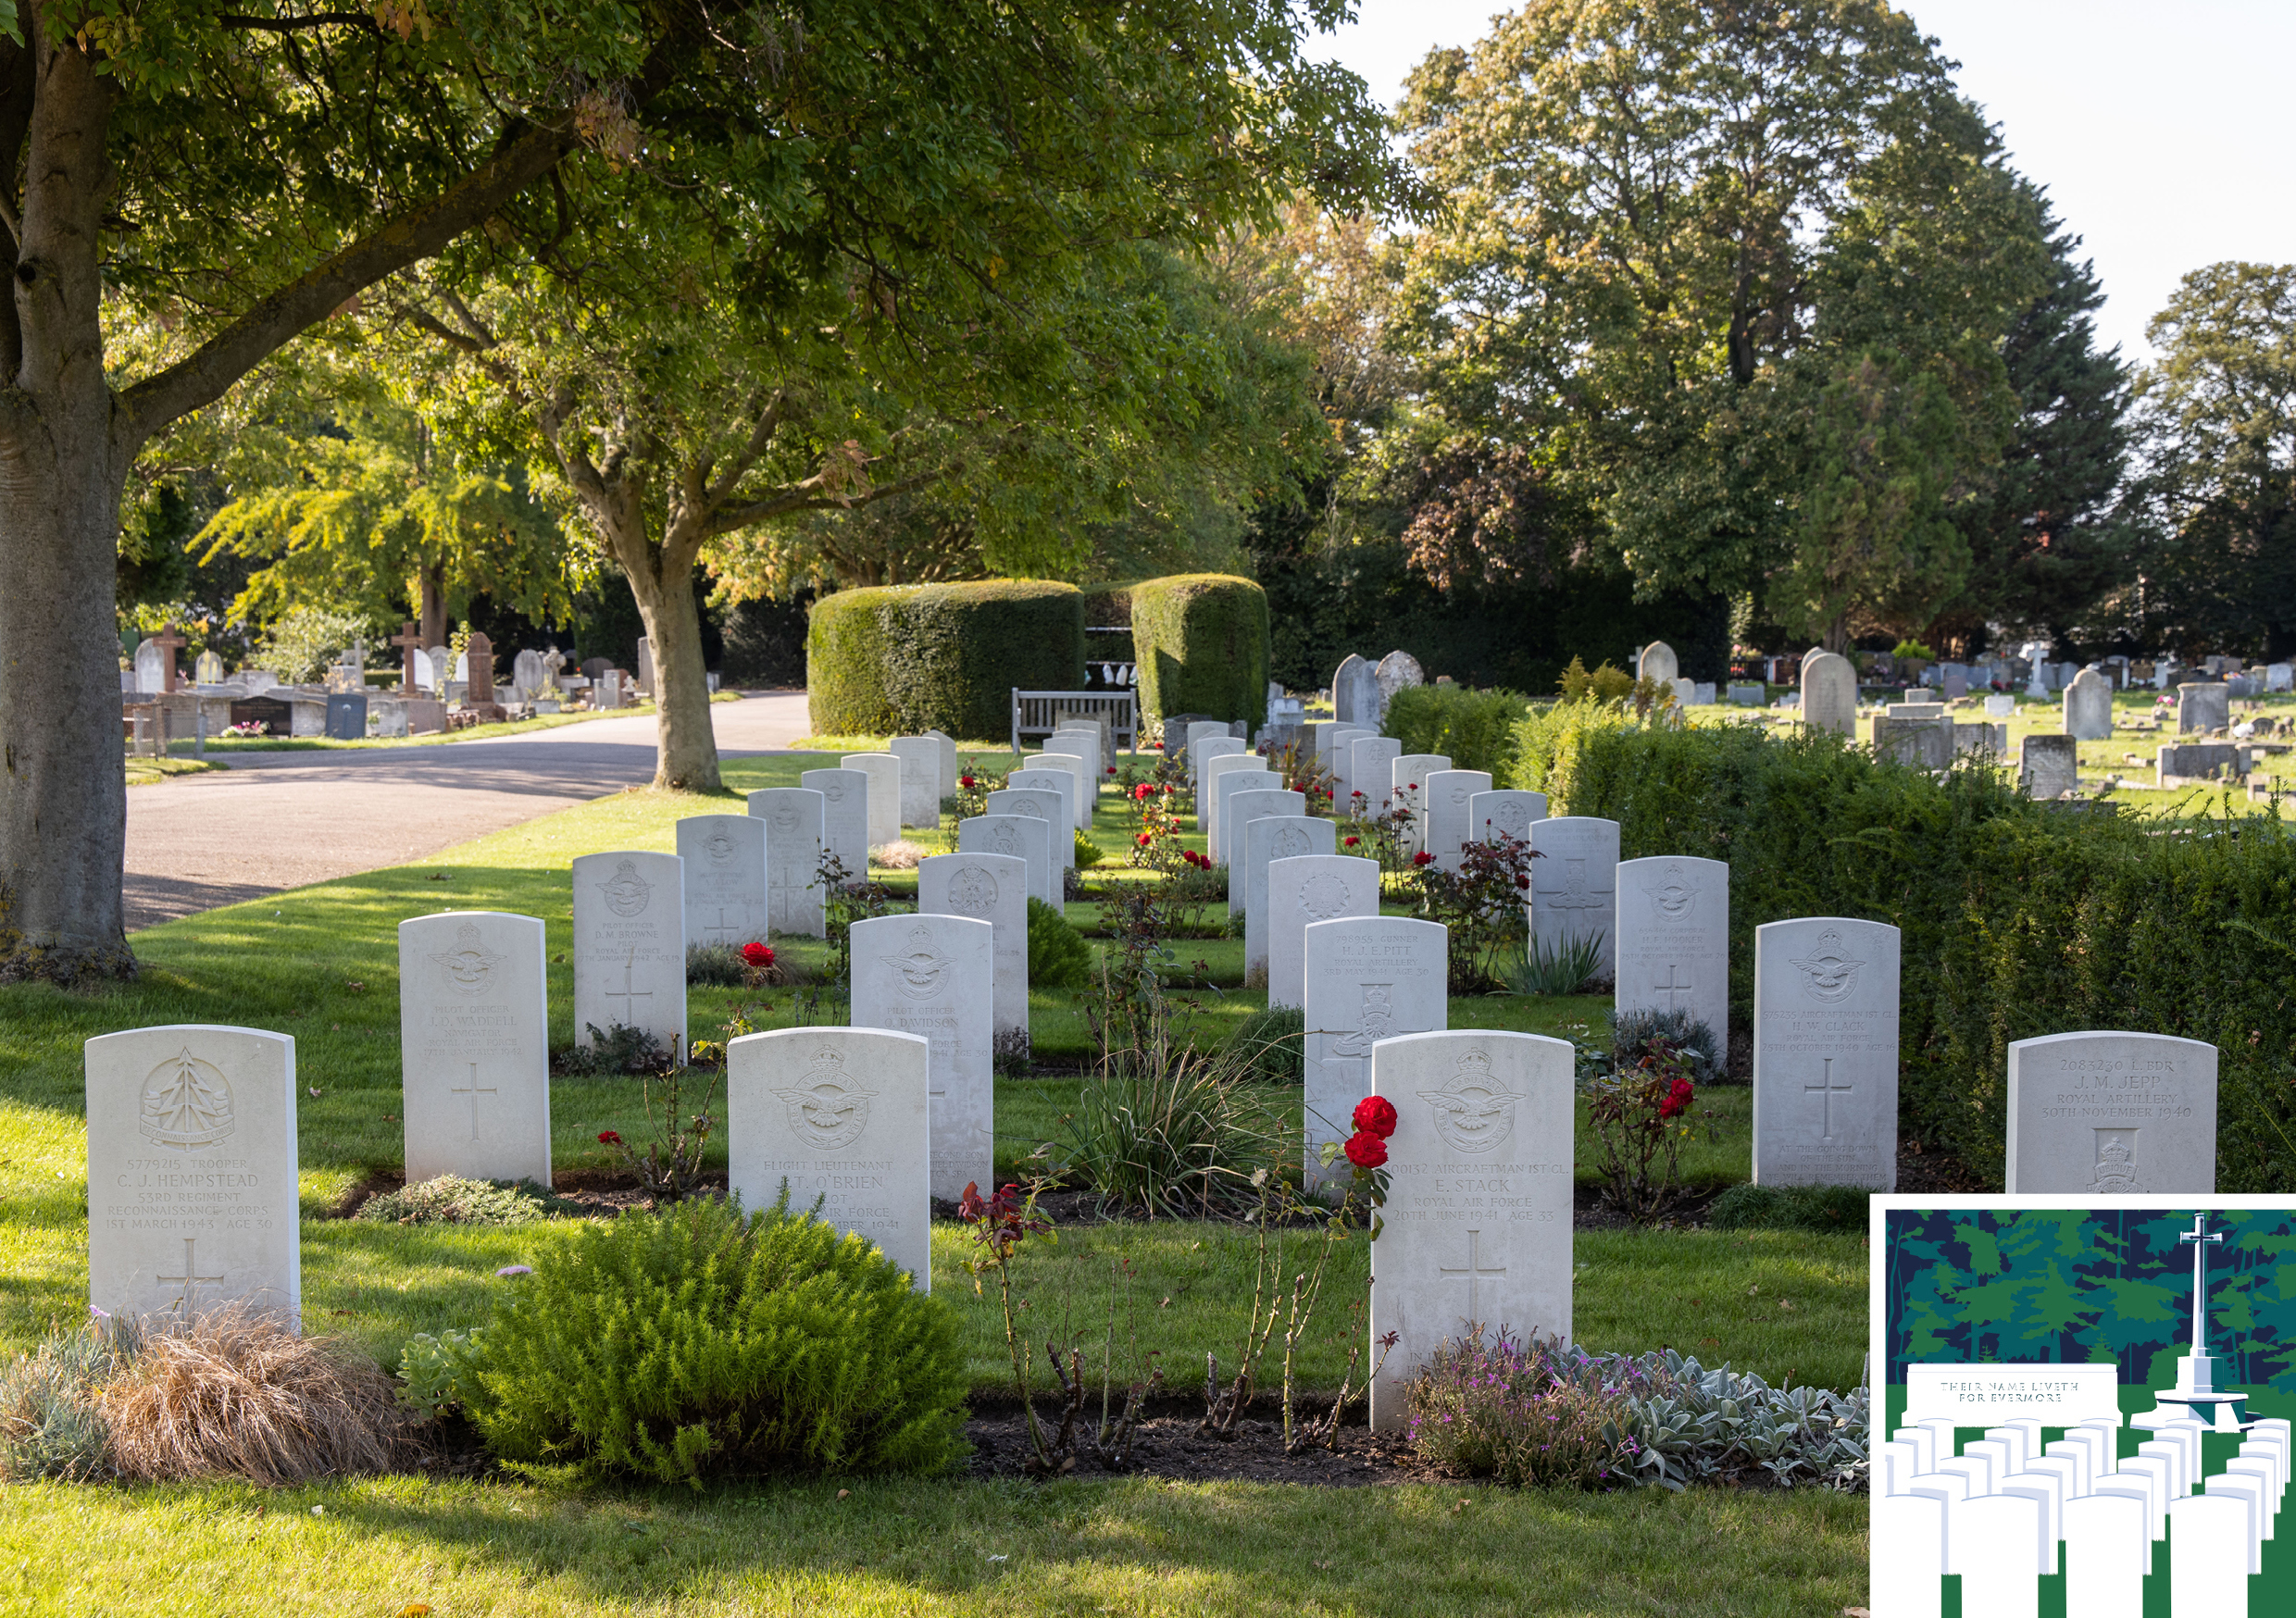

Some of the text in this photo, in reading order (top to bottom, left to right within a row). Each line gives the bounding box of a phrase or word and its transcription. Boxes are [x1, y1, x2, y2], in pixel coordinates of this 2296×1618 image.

[595, 930, 659, 939] D. M. BROWNE
[1642, 936, 1703, 944] H. HOOKER
[1341, 946, 1413, 956] H. J. E. PITT
[1323, 968, 1341, 977] 3RD
[1368, 967, 1388, 977] 1941
[1416, 968, 1429, 977] 30
[434, 1005, 464, 1014] PILOT
[1800, 1011, 1864, 1019] AIRCRAFTMAN
[428, 1016, 517, 1027] J. D. WADDELL
[884, 1017, 959, 1027] O. DAVIDSON
[1792, 1022, 1866, 1032] H. W. CLACK
[429, 1039, 460, 1047] ROYAL
[464, 1039, 481, 1047] AIR
[932, 1039, 962, 1048] FORCE
[1763, 1043, 1786, 1052] 25TH
[1790, 1043, 1832, 1052] OCTOBER
[1835, 1043, 1859, 1053] 1940
[1865, 1043, 1883, 1052] AGE
[451, 1048, 497, 1056] JANUARY
[501, 1047, 522, 1057] 1942
[975, 1050, 988, 1058] 30
[2060, 1059, 2175, 1073] 2083230 L. BDR
[804, 1074, 837, 1087] ARDUA
[1450, 1077, 1485, 1091] ARDUA
[2074, 1076, 2161, 1089] J. M. JEPP
[2057, 1094, 2178, 1104] ROYAL ARTILLERY
[2041, 1106, 2192, 1121] 30TH NOVEMBER 1940
[142, 1125, 232, 1142] RECONNAISSANCE CORPS
[1779, 1145, 1877, 1153] AT THE GOING DOWN
[1816, 1154, 1834, 1163] THE
[1837, 1154, 1856, 1163] SUN
[127, 1159, 247, 1170] 5779215 TROOPER
[764, 1161, 893, 1171] FLIGHT LIEUTENANT
[1434, 1164, 1525, 1175] AIRCRAFTMAN
[1551, 1164, 1569, 1175] CL.
[2098, 1164, 2132, 1175] UBIQUE
[952, 1170, 967, 1178] SPA
[1766, 1173, 1887, 1181] WE WILL REMEMBER THEM
[117, 1174, 258, 1188] C. J. HEMPSTEAD
[816, 1175, 883, 1189] O'BRIEN
[1434, 1179, 1511, 1193] E. STACK
[139, 1192, 241, 1203] 53RD REGIMENT
[1414, 1197, 1533, 1208] ROYAL AIR FORCE
[107, 1205, 268, 1216] RECONNAISSANCE CORPS
[821, 1207, 842, 1218] AIR
[849, 1207, 891, 1218] FORCE
[1393, 1210, 1554, 1224] 20TH JUNE 1941 AGE 33
[131, 1218, 273, 1229] MARCH 1943 AGE 30
[872, 1220, 899, 1230] 1941
